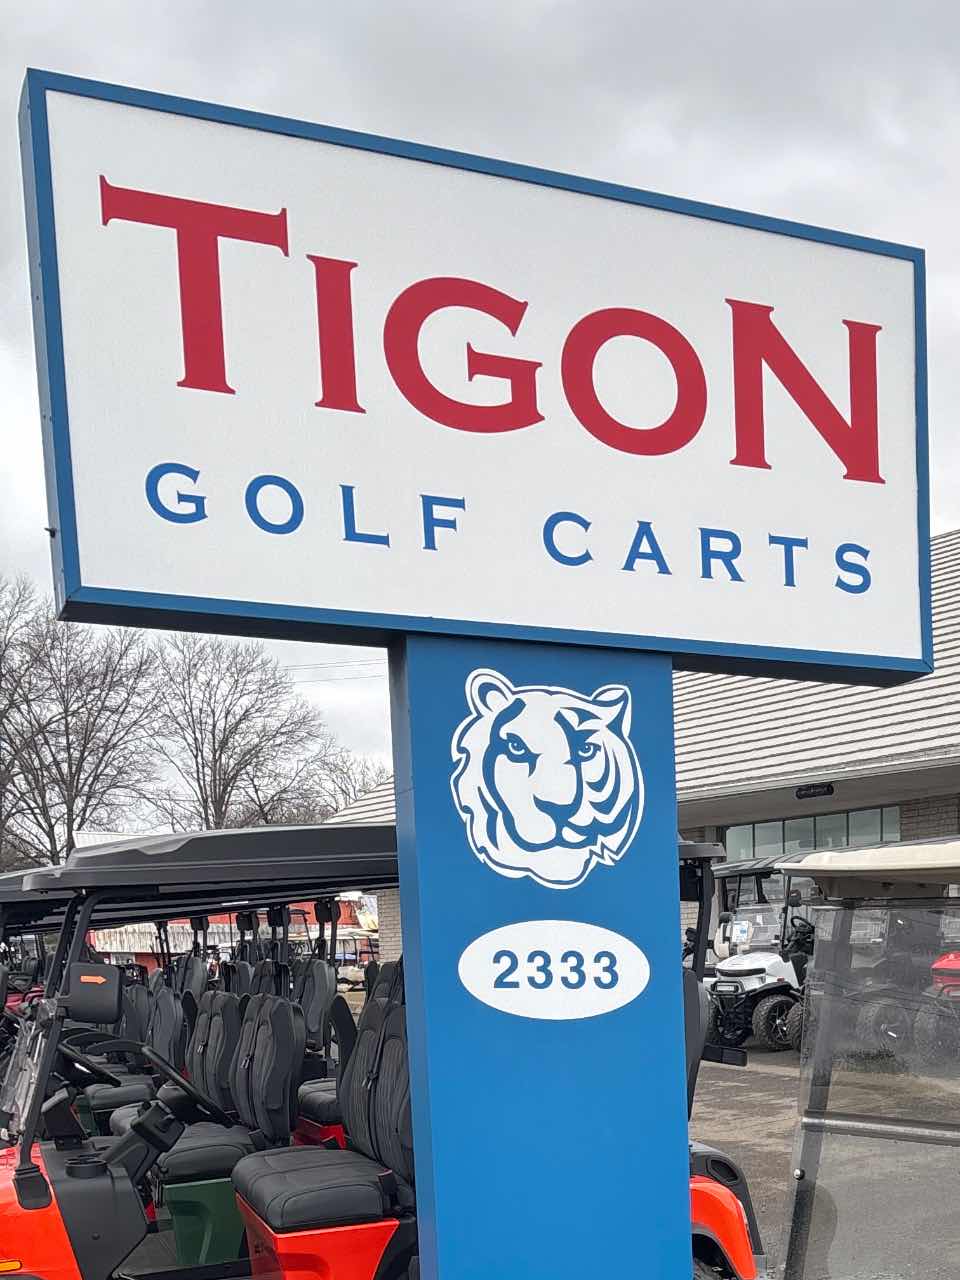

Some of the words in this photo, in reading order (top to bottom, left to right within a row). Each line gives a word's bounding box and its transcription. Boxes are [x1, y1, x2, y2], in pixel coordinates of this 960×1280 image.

[99, 175, 886, 485] TIGON
[144, 463, 466, 552] GOLF
[542, 511, 873, 595] CARTS
[492, 949, 619, 990] 2333
